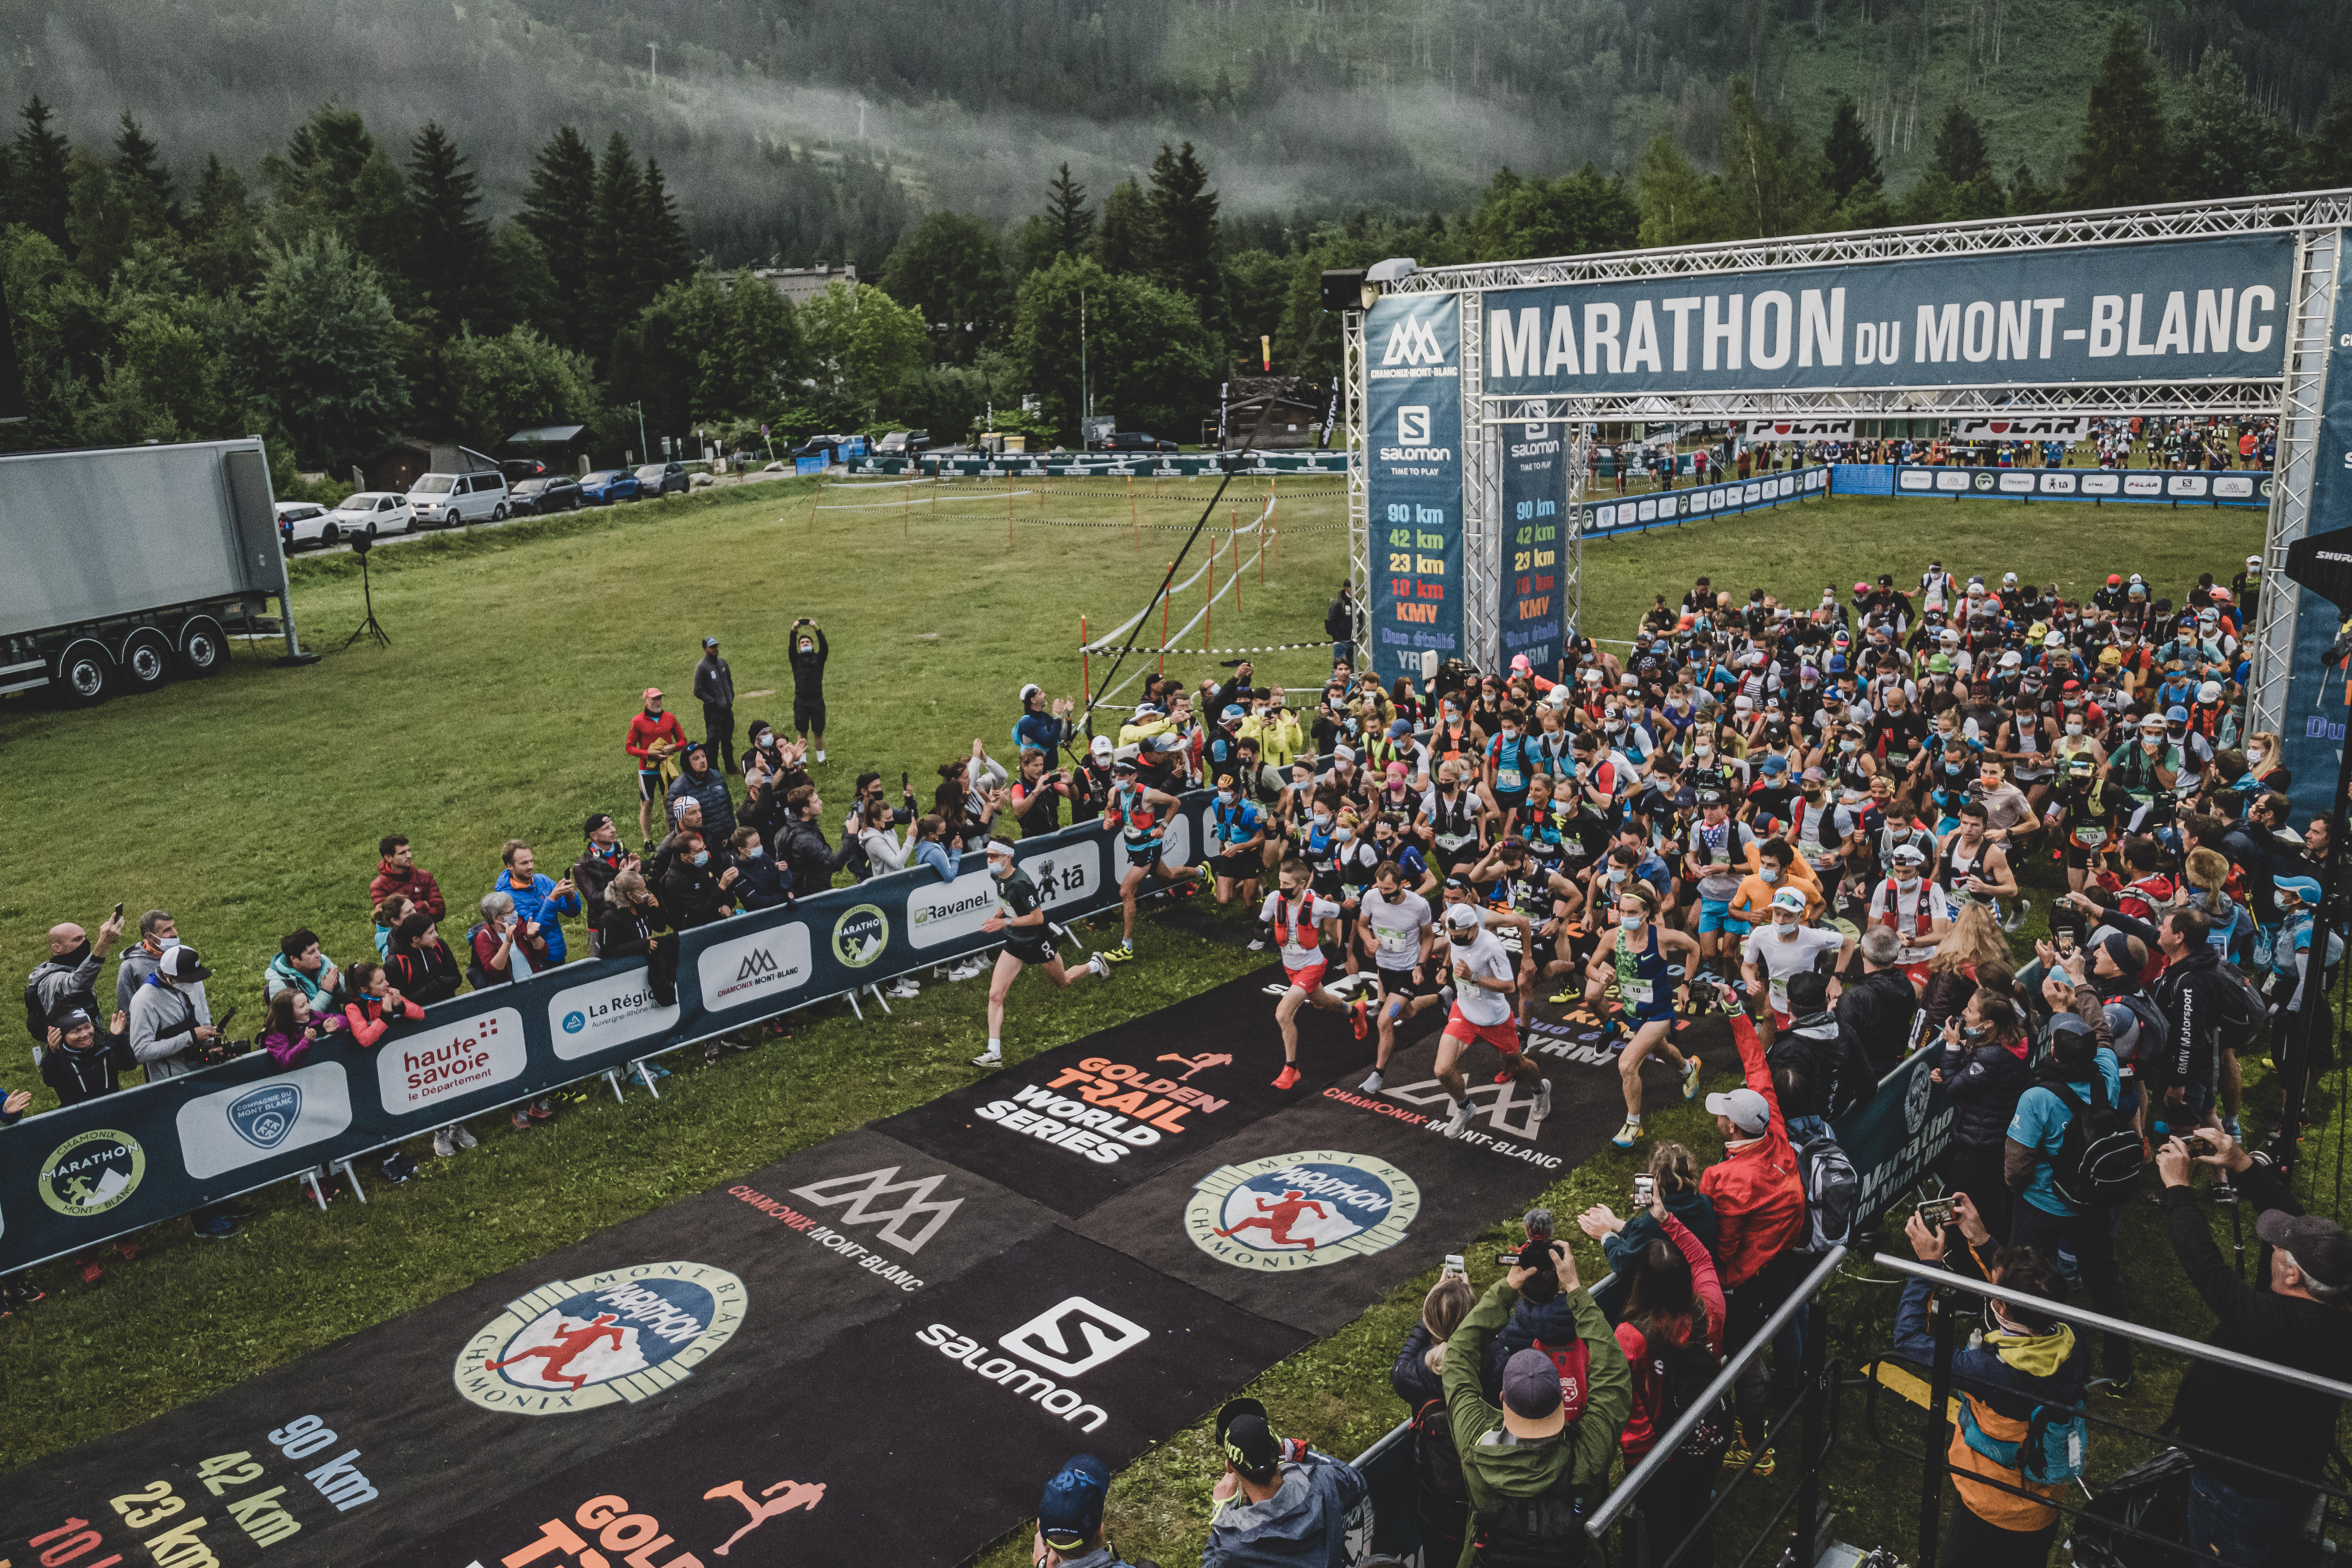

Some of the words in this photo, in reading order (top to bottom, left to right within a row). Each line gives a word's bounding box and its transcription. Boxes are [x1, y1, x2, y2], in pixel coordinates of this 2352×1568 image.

[1490, 286, 1846, 378] MARATHON
[1854, 321, 1901, 366] DU
[1915, 284, 2276, 363] MONT-BLANC
[1371, 367, 1458, 378] CHAMONIX-MONT-BLANC
[1380, 448, 1450, 461] salomon
[1511, 440, 1560, 458] salomon
[1388, 504, 1409, 524] 90
[1416, 504, 1443, 524] km
[1516, 501, 1533, 521] 90
[1536, 498, 1555, 516] km
[1389, 529, 1410, 548] 42
[1416, 529, 1443, 549] km
[1516, 526, 1532, 545] 42
[1535, 524, 1555, 542] km
[1389, 553, 1410, 572] 23
[1416, 554, 1444, 574] km
[1515, 551, 1530, 571] 23
[1534, 548, 1554, 567] km
[1392, 579, 1410, 596] 10
[1417, 579, 1443, 599] km
[1516, 577, 1530, 595] 10
[1535, 574, 1554, 591] km
[1396, 603, 1437, 623] KMV
[1519, 596, 1549, 620] KMV
[1382, 628, 1408, 646] Duo
[1413, 631, 1455, 650] étoilé
[1507, 631, 1528, 647] Duo
[1532, 621, 1559, 642] étoilé
[1397, 650, 1421, 670] YR
[2306, 716, 2346, 740] Du
[843, 905, 876, 919] CHAMONIX
[928, 890, 987, 919] Ravanel
[833, 917, 887, 937] MARATHON
[844, 957, 860, 967] MONT
[865, 948, 883, 964] BLANC
[717, 967, 798, 997] CHAMONIX-MONT-BLANC
[589, 1005, 608, 1018] La
[2180, 988, 2193, 1046] Motorsport
[404, 1037, 477, 1072] haute
[1526, 1034, 1617, 1066] YRM
[2178, 1048, 2190, 1074] BMW
[407, 1052, 490, 1089] savoie
[409, 1092, 418, 1102] le
[421, 1068, 492, 1098] Département
[1078, 1057, 1230, 1114] GOLDEN
[237, 1095, 276, 1112] COMPAGNIE
[279, 1090, 292, 1099] DU
[238, 1107, 264, 1118] MONT
[265, 1096, 293, 1111] BLANC
[1012, 1084, 1162, 1147] WORLD
[1046, 1067, 1192, 1134] TRAIL
[57, 1131, 118, 1155] CHAMONIX
[974, 1099, 1131, 1164] SERIES
[1322, 1087, 1563, 1169] CHAMONIX-MNT-BLANC
[41, 1141, 139, 1182] MARATHON
[1860, 1106, 1954, 1202] Maratho
[1258, 1151, 1360, 1170] MONT
[1377, 1168, 1416, 1225] BLANC
[1266, 1164, 1394, 1213] MARATHON
[1880, 1156, 1921, 1203] Mont
[63, 1204, 94, 1214] MONT
[104, 1184, 135, 1208] BLANC
[728, 1185, 924, 1292] CHAMONIX-MONT-BLANC
[1191, 1207, 1318, 1267] CHAMONIX
[594, 1264, 710, 1286] MONT
[686, 1282, 736, 1360] BLANC
[594, 1281, 707, 1343] MARATHON
[463, 1334, 575, 1409] CHAMONIX
[915, 1323, 1108, 1434] salomon
[195, 1450, 265, 1496] 42
[268, 1415, 338, 1460] 90
[304, 1449, 379, 1512] km
[109, 1480, 186, 1529] 23
[226, 1485, 302, 1548] km
[28, 1516, 103, 1568] 10
[144, 1516, 220, 1568] km
